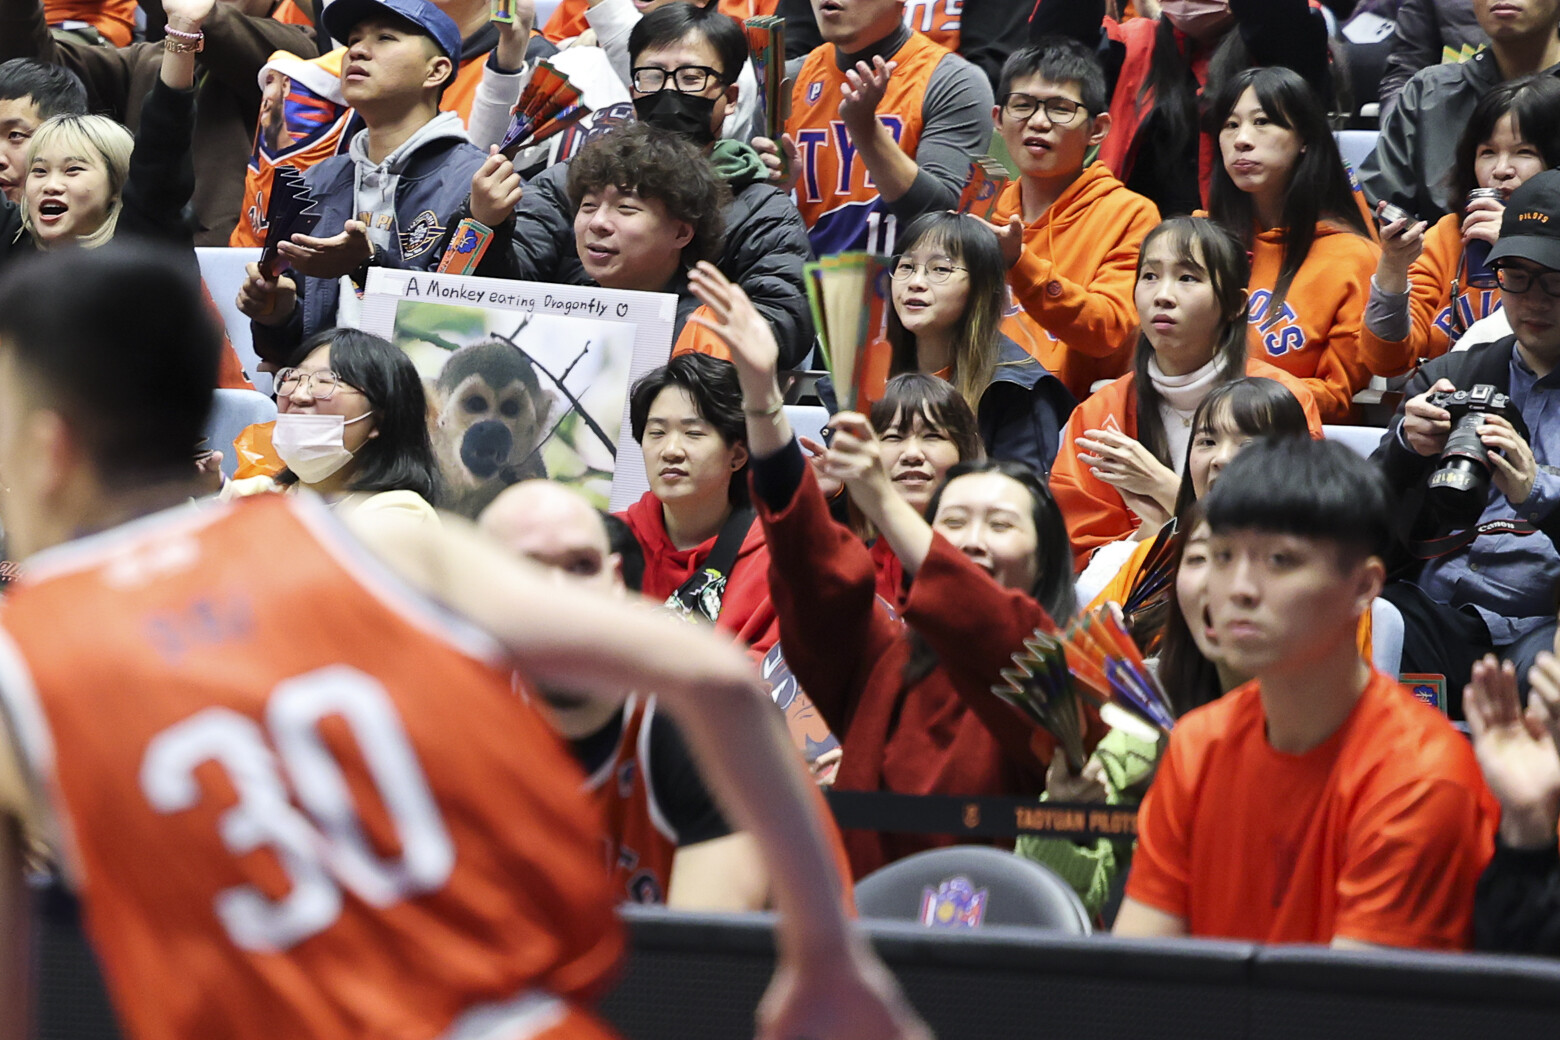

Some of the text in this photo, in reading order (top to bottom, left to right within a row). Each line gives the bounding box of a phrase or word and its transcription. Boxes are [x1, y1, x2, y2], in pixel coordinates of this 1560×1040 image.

[1518, 211, 1550, 224] PILOTS
[405, 276, 608, 317] A Monkey eating Dragonfly
[1478, 520, 1515, 533] Canon
[140, 662, 457, 953] 30
[1015, 806, 1086, 832] TAOYUAN
